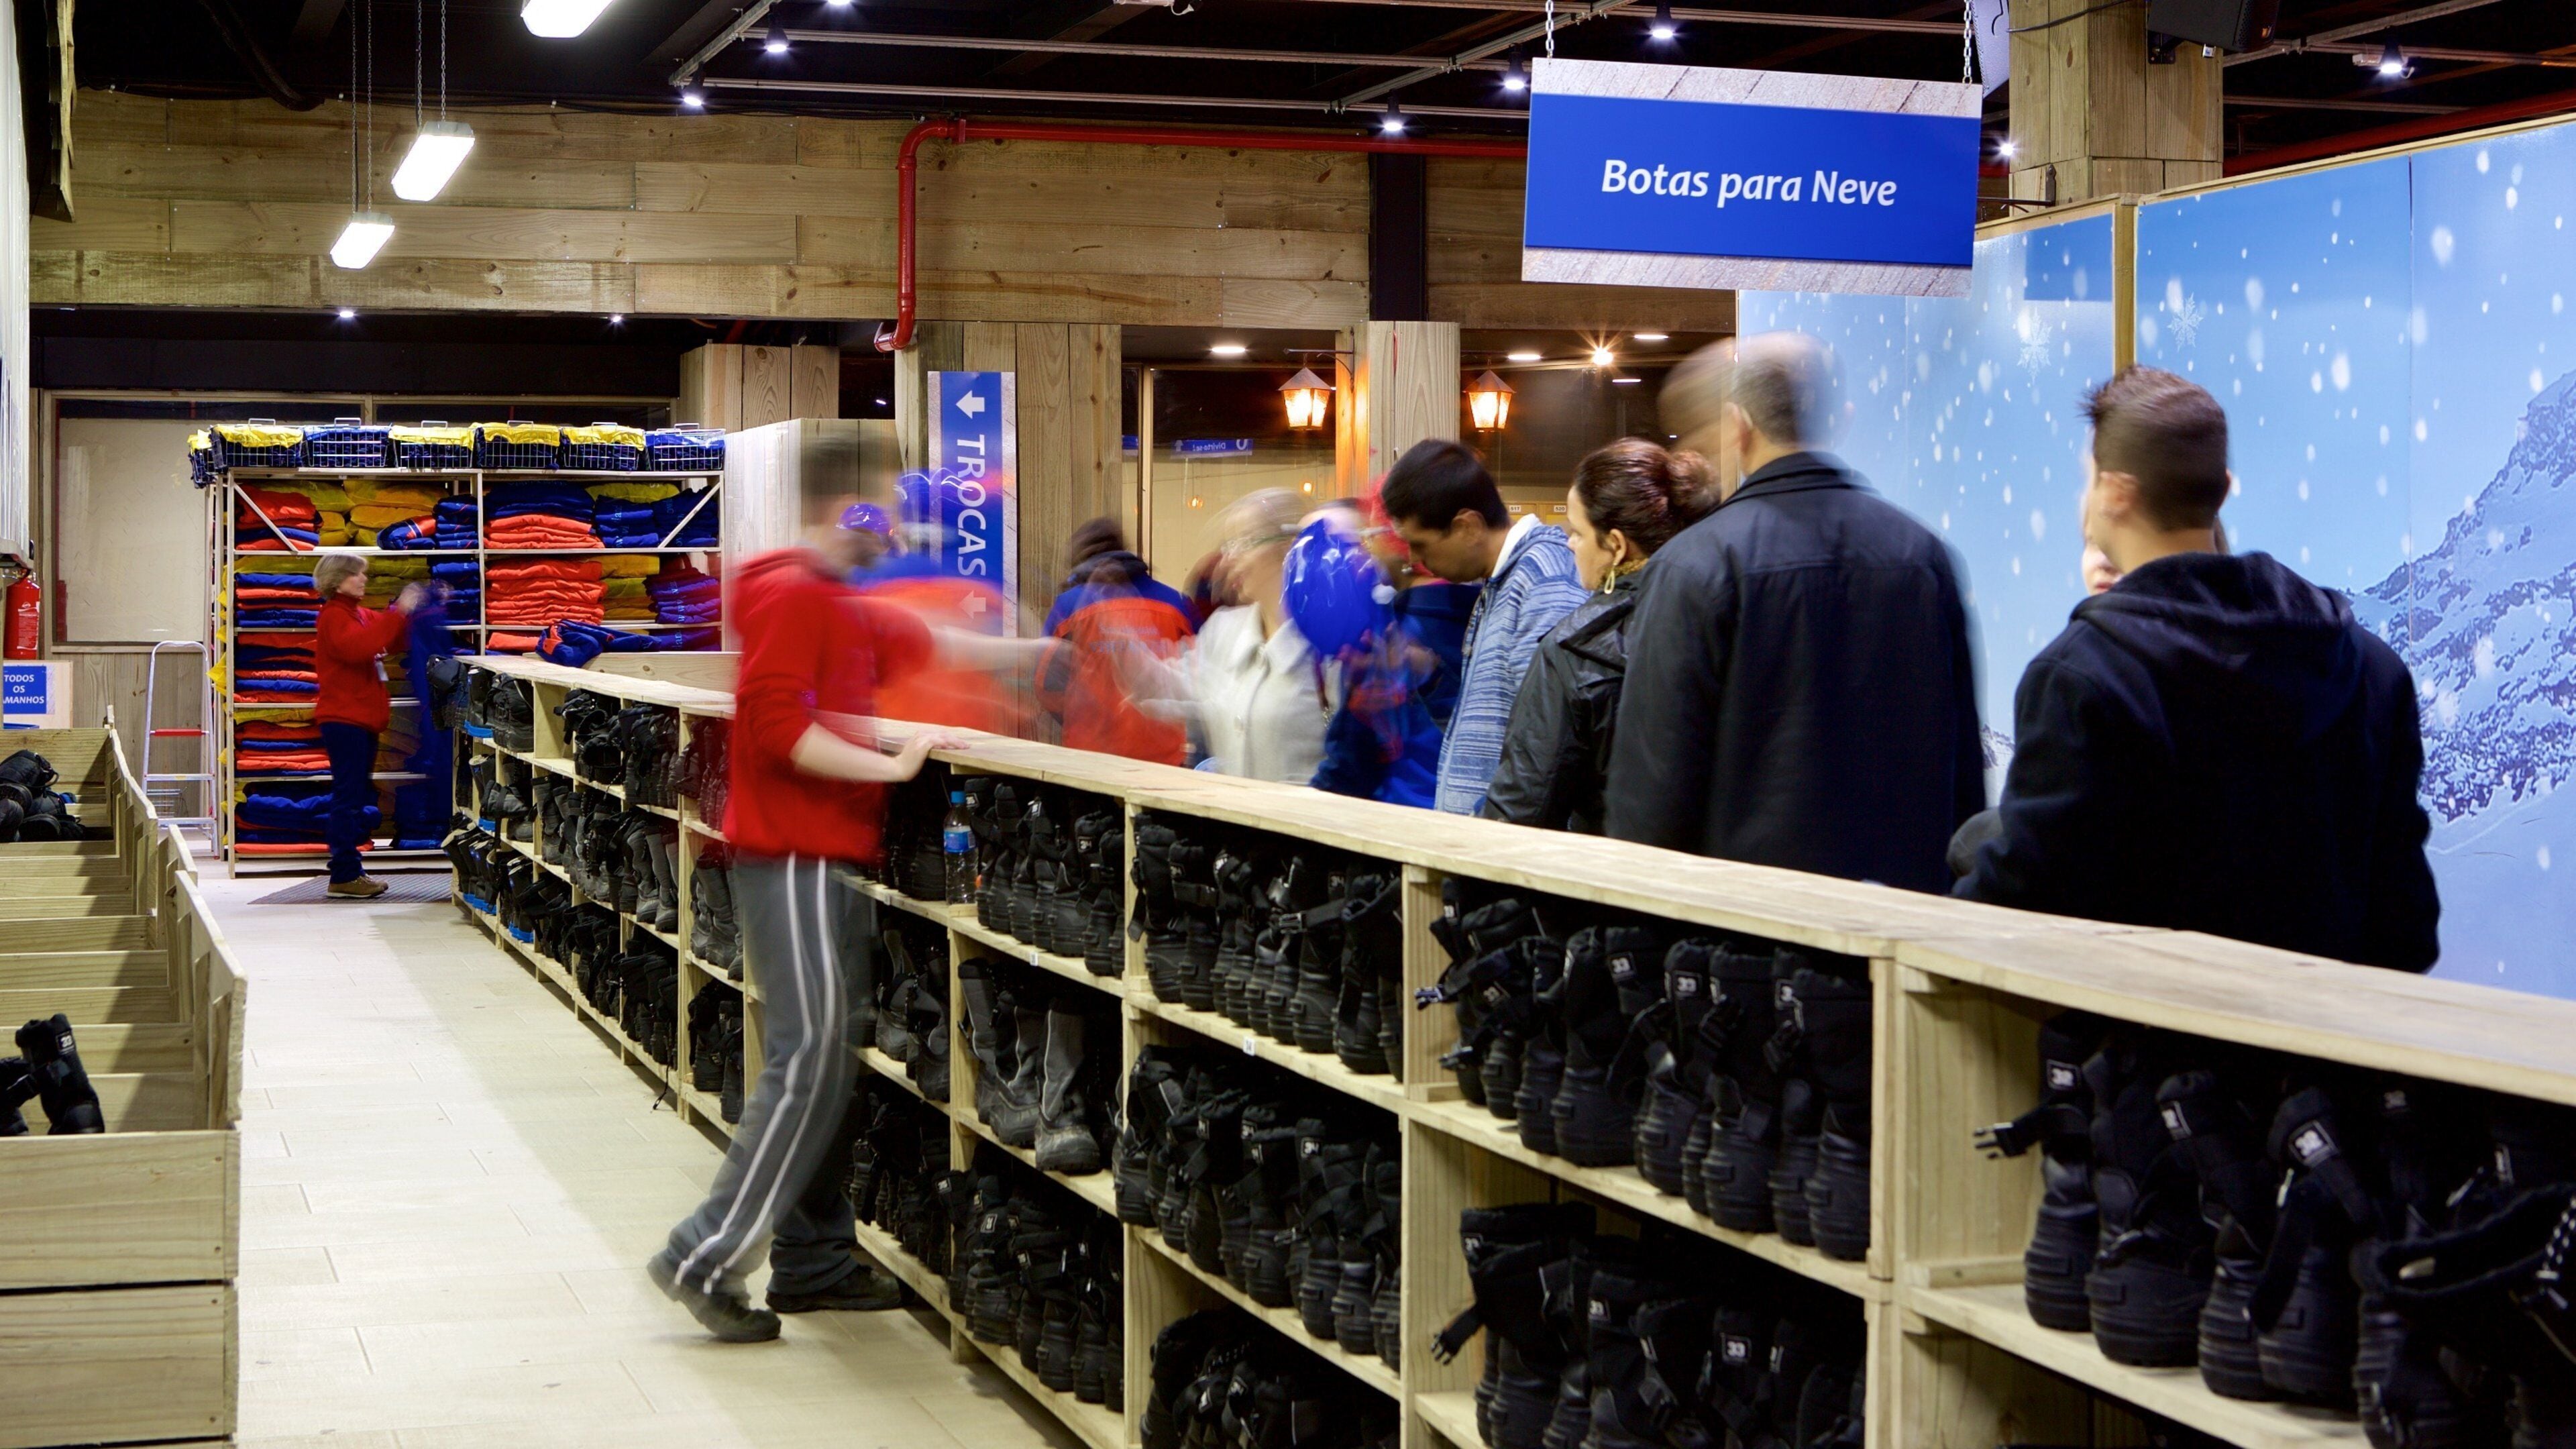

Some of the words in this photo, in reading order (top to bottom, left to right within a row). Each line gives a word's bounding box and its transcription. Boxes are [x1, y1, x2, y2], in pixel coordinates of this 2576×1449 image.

[1601, 159, 1709, 197] Botas
[1717, 173, 1802, 208] para
[1811, 170, 1897, 206] Neve
[957, 434, 986, 576] TROCAS
[4, 674, 35, 682] TODOS
[13, 685, 25, 693] OS
[1330, 875, 1345, 888] 34
[1612, 957, 1630, 974] 33
[1678, 977, 1697, 991] 33
[60, 1035, 72, 1048] 33
[1304, 1141, 1320, 1154] 34
[1727, 1341, 1746, 1358] 33
